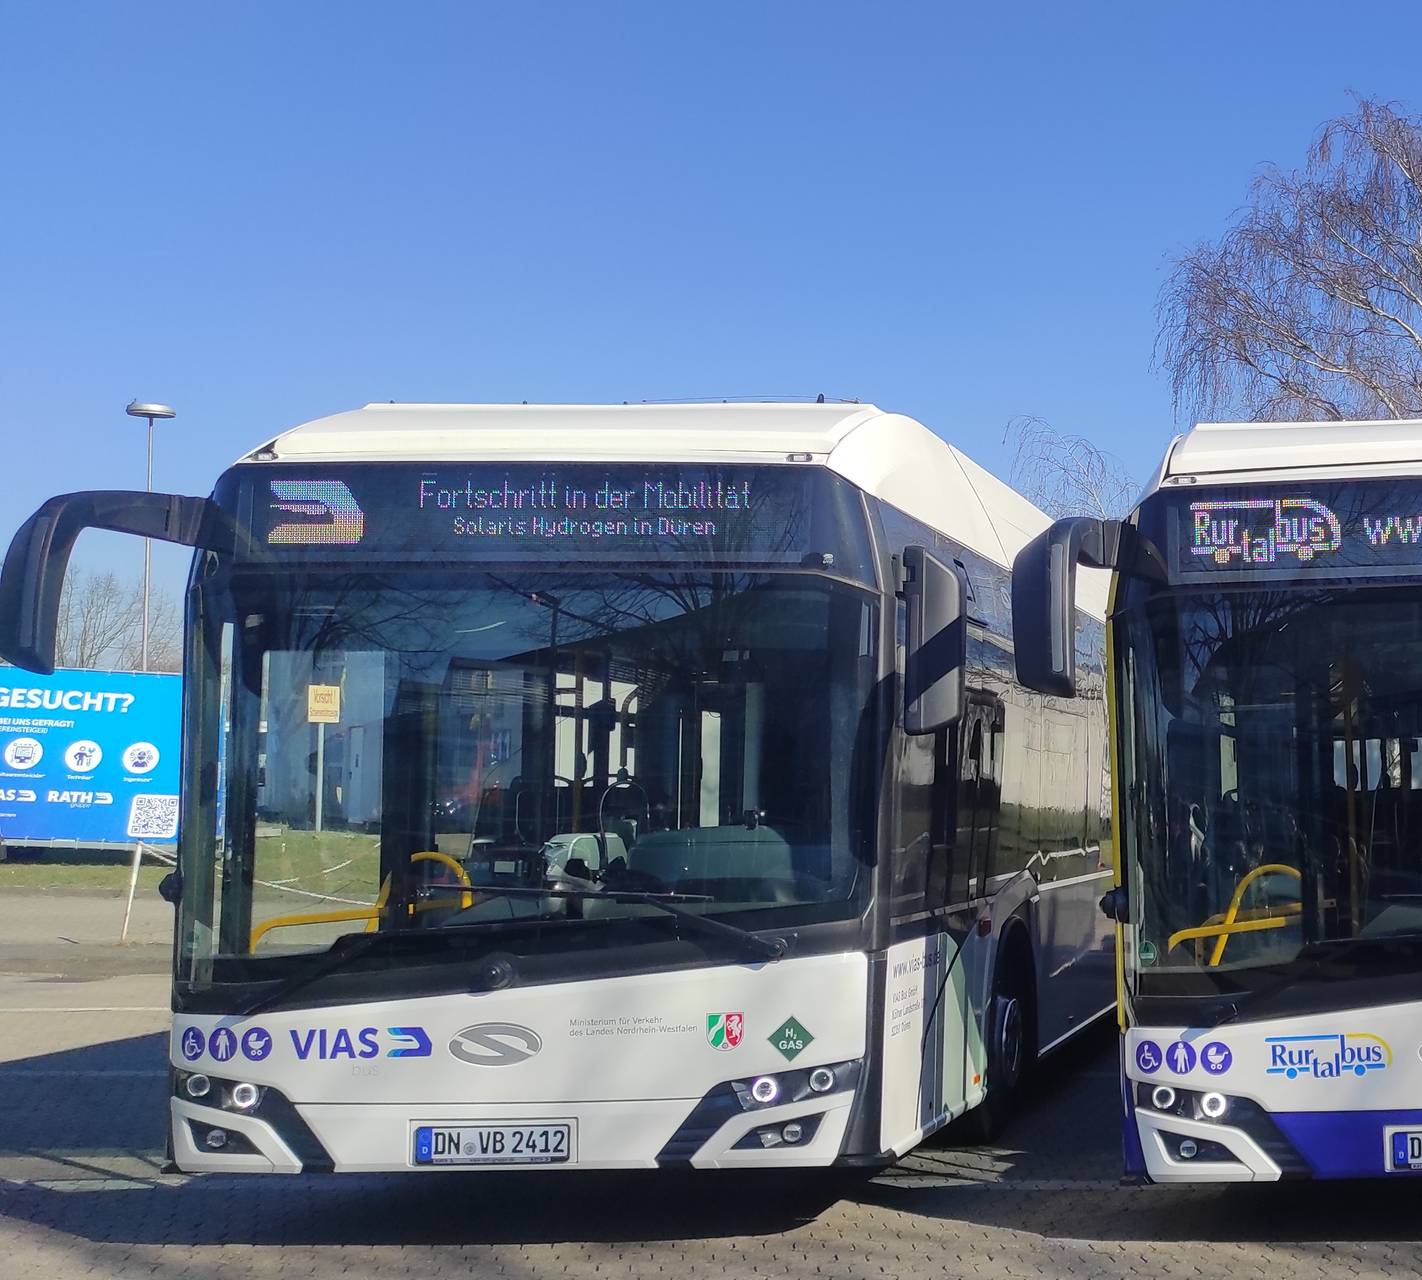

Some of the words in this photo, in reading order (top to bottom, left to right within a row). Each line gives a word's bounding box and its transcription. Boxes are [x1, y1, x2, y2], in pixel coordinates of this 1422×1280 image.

[419, 480, 556, 509] Fortschritt
[565, 484, 585, 509] in
[597, 481, 636, 509] der
[643, 480, 752, 509] Mobilität
[453, 516, 527, 536] Solaris
[532, 516, 628, 539] Hydrogen
[633, 516, 653, 535] in
[657, 516, 717, 536] Düren
[0, 688, 136, 713] GESUCHT?
[47, 790, 93, 804] RATH
[569, 1017, 618, 1028] Ministerium
[619, 1016, 631, 1026] für
[632, 1015, 663, 1026] Verkehr
[569, 1028, 584, 1037] des
[586, 1027, 615, 1037] Landes
[288, 1026, 380, 1060] VIAS
[778, 1039, 803, 1051] GAS
[421, 1145, 428, 1154] D
[433, 1131, 461, 1155] DN
[479, 1131, 505, 1154] VB
[511, 1130, 566, 1154] 2412
